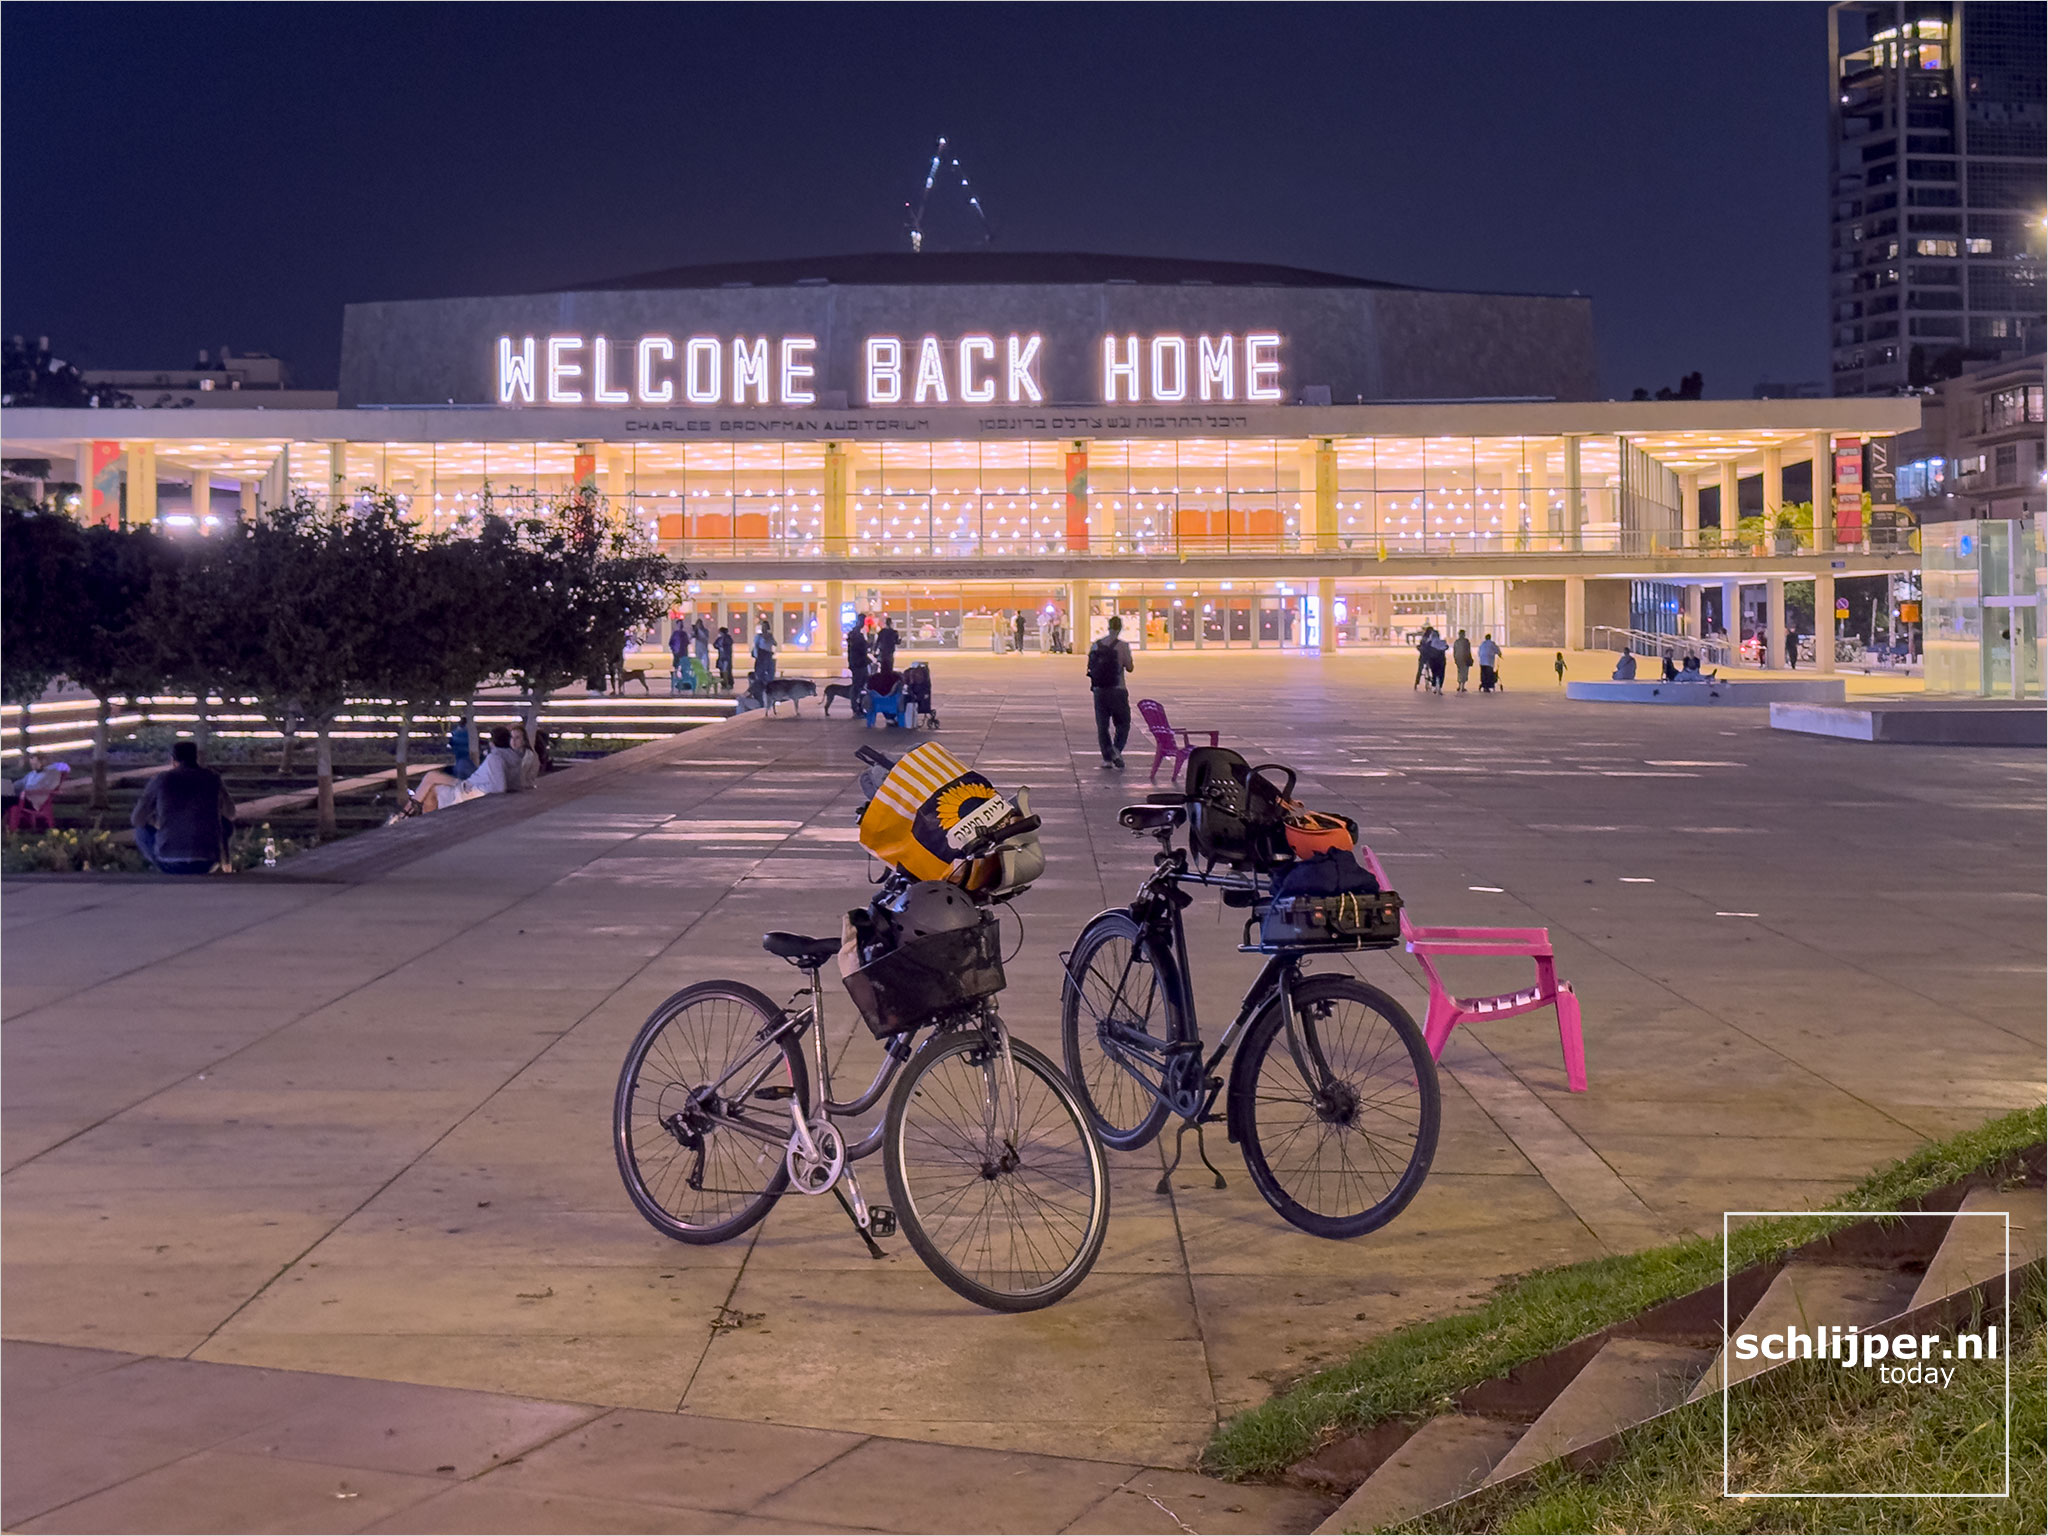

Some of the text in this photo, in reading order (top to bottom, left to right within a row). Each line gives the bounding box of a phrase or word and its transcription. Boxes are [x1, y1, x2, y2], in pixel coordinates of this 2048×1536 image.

[499, 335, 1282, 403] WELCOME BACK HOME
[625, 419, 929, 431] CHARLES BRONFMAN AUDITORIUM
[1136, 417, 1202, 428] התרבות
[1205, 415, 1247, 427] היכל
[1872, 442, 1895, 480] JAZZ
[983, 799, 1005, 822] ליית
